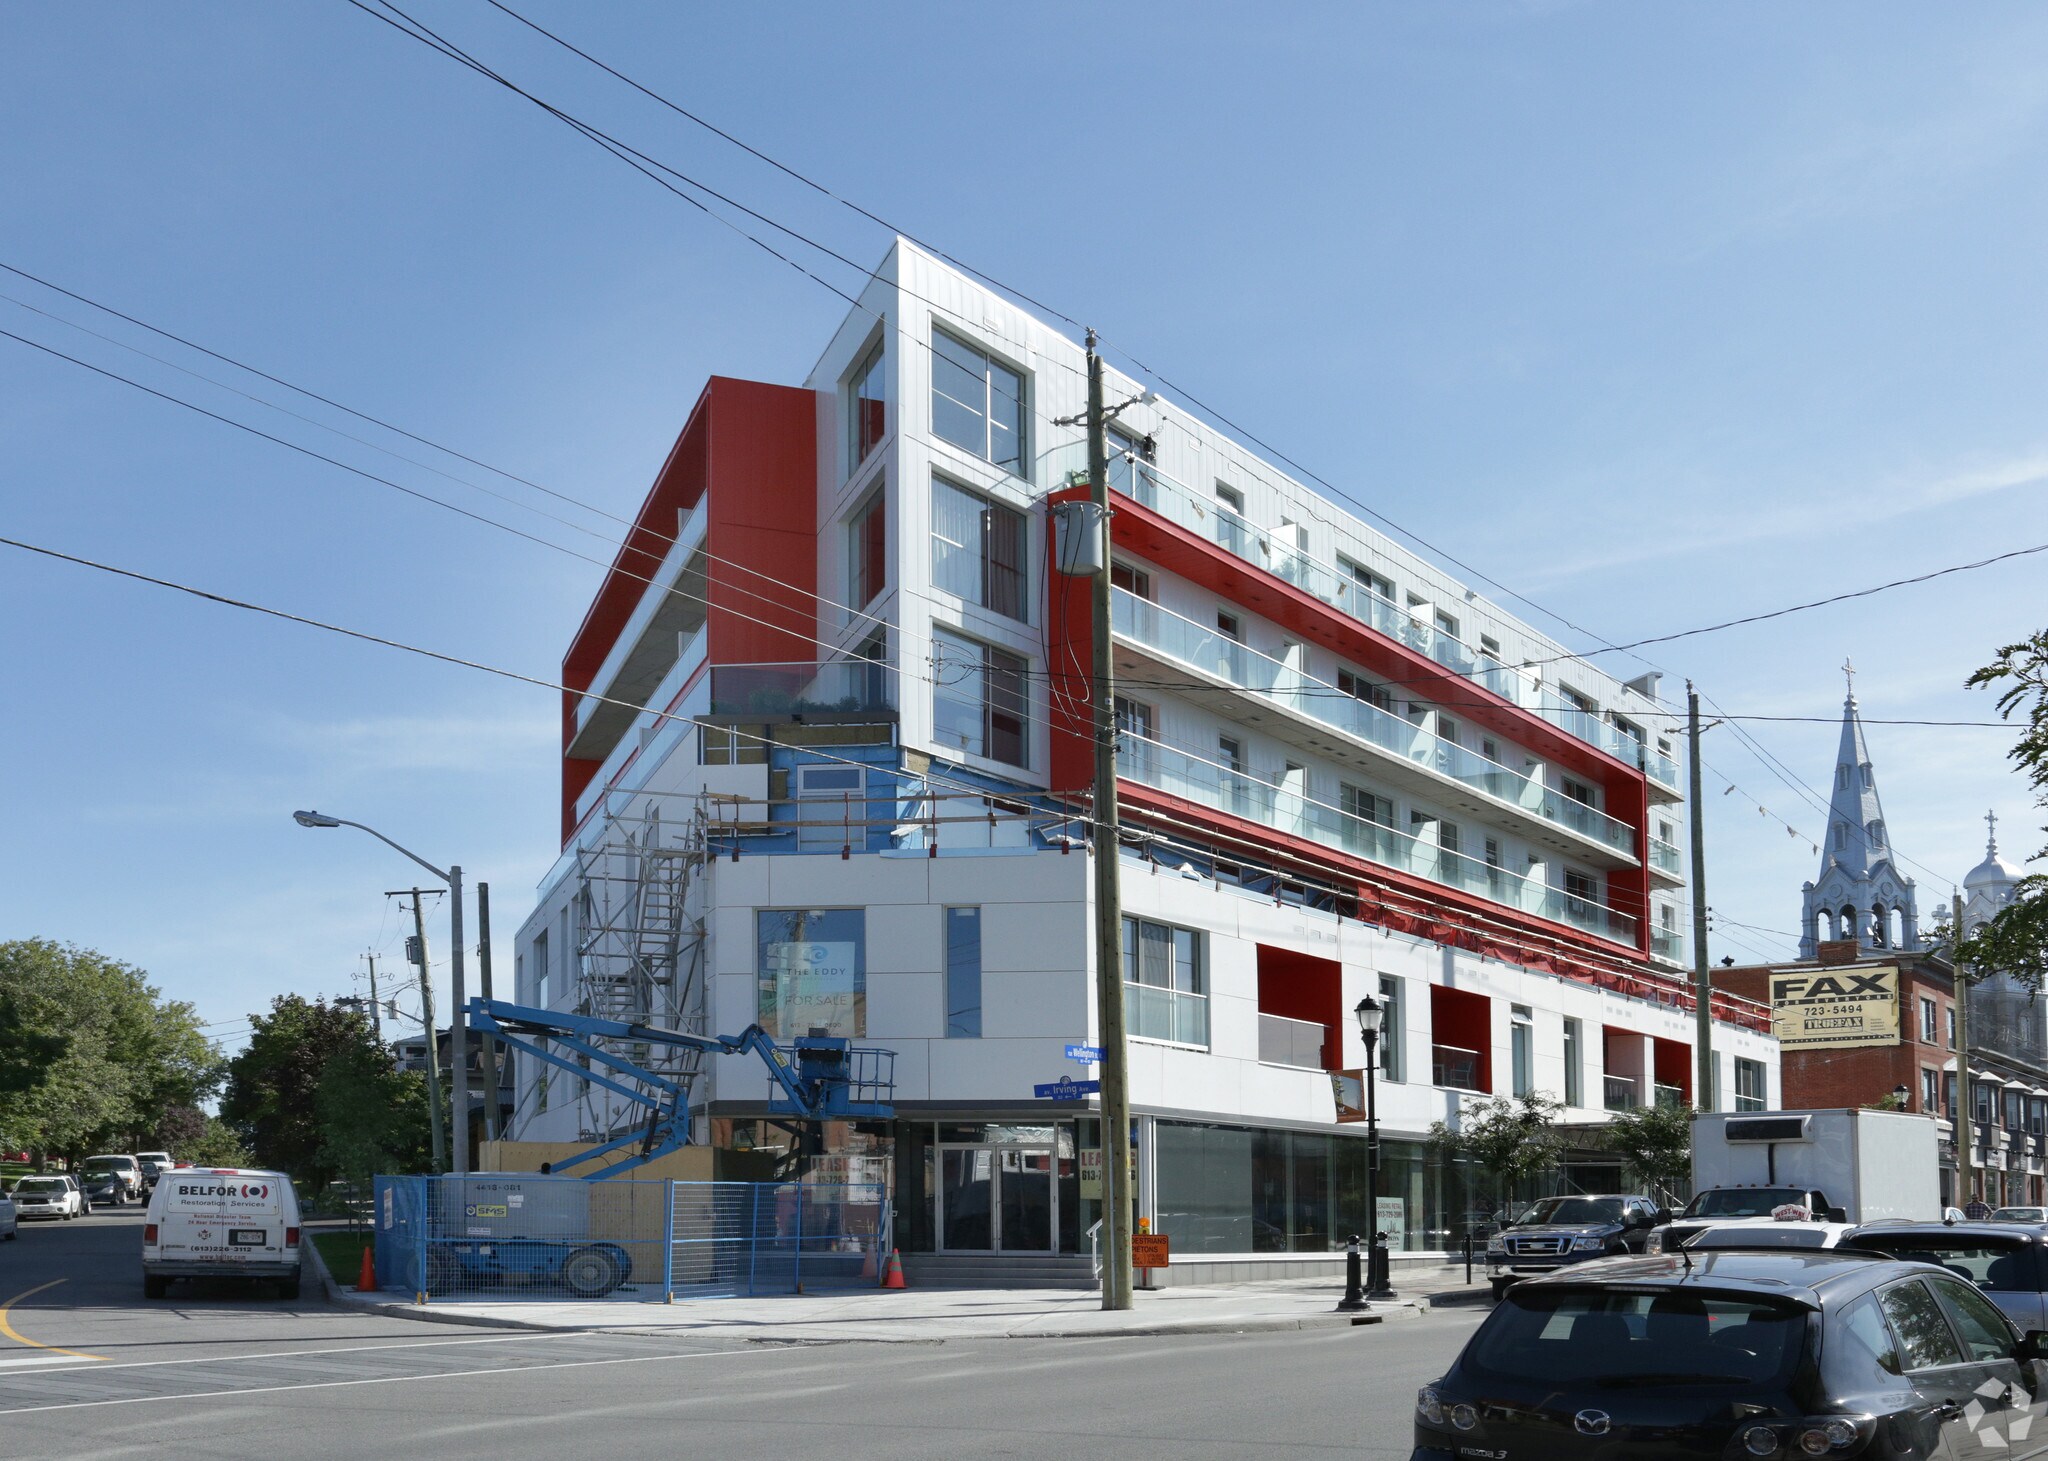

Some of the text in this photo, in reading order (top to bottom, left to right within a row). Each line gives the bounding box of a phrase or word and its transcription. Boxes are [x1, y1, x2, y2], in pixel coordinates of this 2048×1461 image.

[786, 968, 847, 976] THE EDDY
[1774, 973, 1893, 999] FAX
[785, 995, 848, 1006] FOR SALE
[1814, 994, 1893, 1004] EVERYONE
[1805, 1016, 1862, 1030] TRUEFAX
[1053, 1084, 1077, 1095] Irving
[178, 1185, 237, 1197] BELFOR
[180, 1199, 266, 1208] Restoration Services
[478, 1206, 506, 1216] SMS
[190, 1245, 252, 1253] (613)226-3112
[1460, 1446, 1508, 1460] mazda 3
